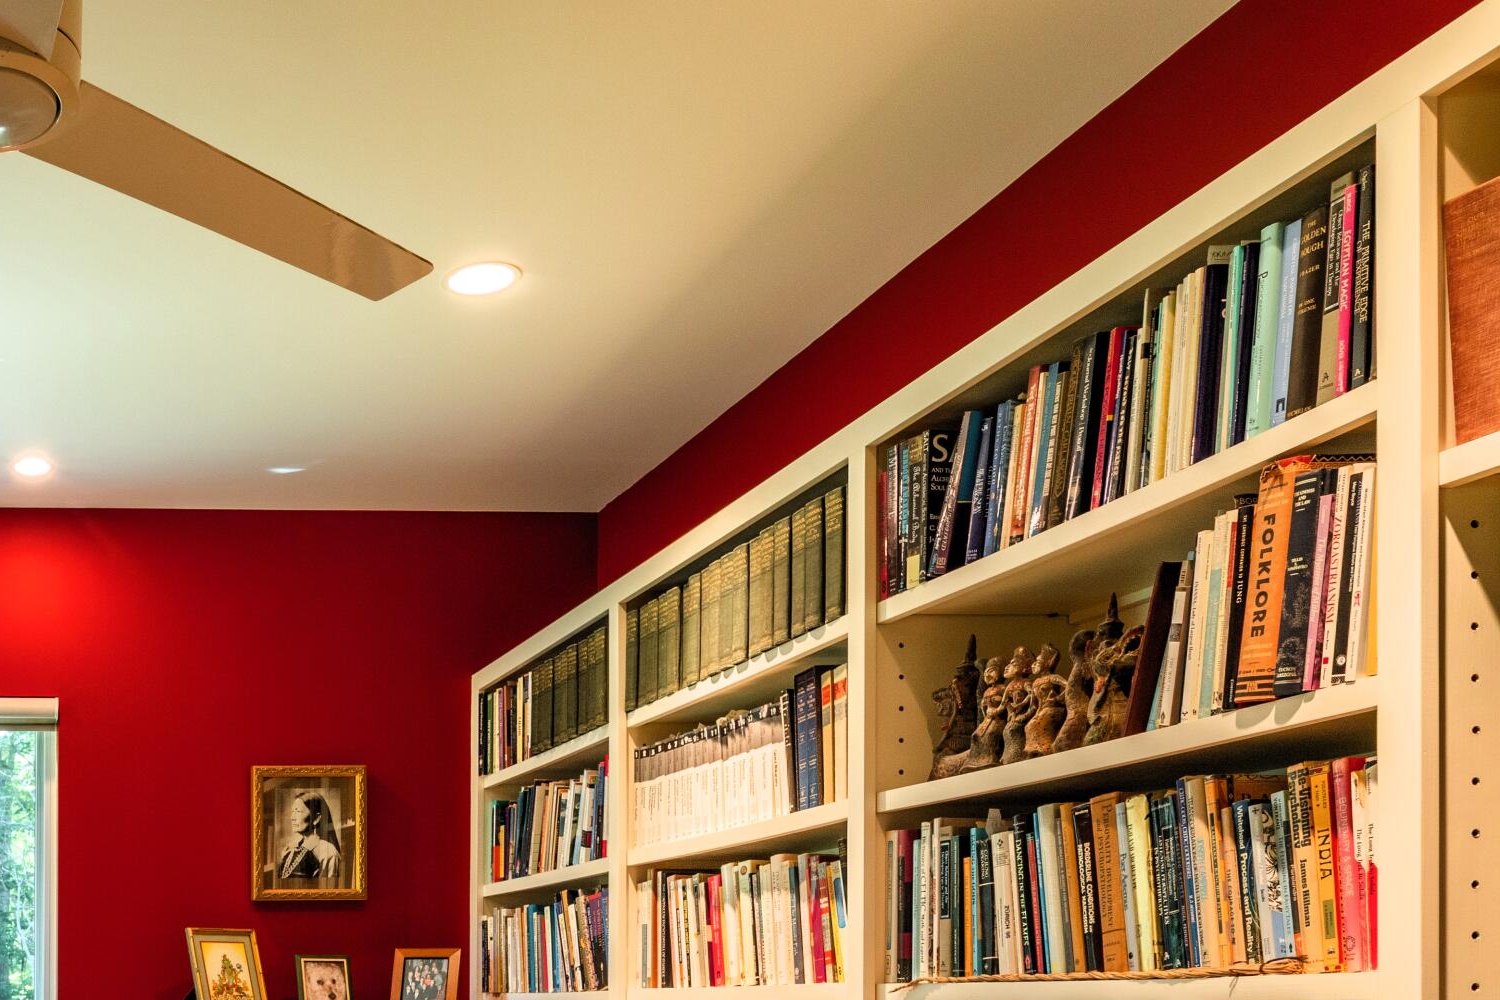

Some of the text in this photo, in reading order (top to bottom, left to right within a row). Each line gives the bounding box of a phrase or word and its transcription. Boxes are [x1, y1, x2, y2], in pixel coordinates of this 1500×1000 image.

[1340, 230, 1352, 312] EGYPTIAN MAGIC
[1360, 246, 1370, 293] PRIMITIVE
[1359, 296, 1368, 324] EDGE
[1235, 580, 1244, 604] JUNG
[1250, 513, 1276, 637] FOLKLORE
[1236, 805, 1245, 849] Whitehead
[1015, 839, 1024, 880] DANCING
[1240, 853, 1250, 895] Process
[1318, 828, 1332, 880] INDIA
[1084, 842, 1095, 924] BORDERLINE CONDITIONS
[1299, 859, 1311, 927] James Hillman
[1245, 918, 1254, 953] Reality
